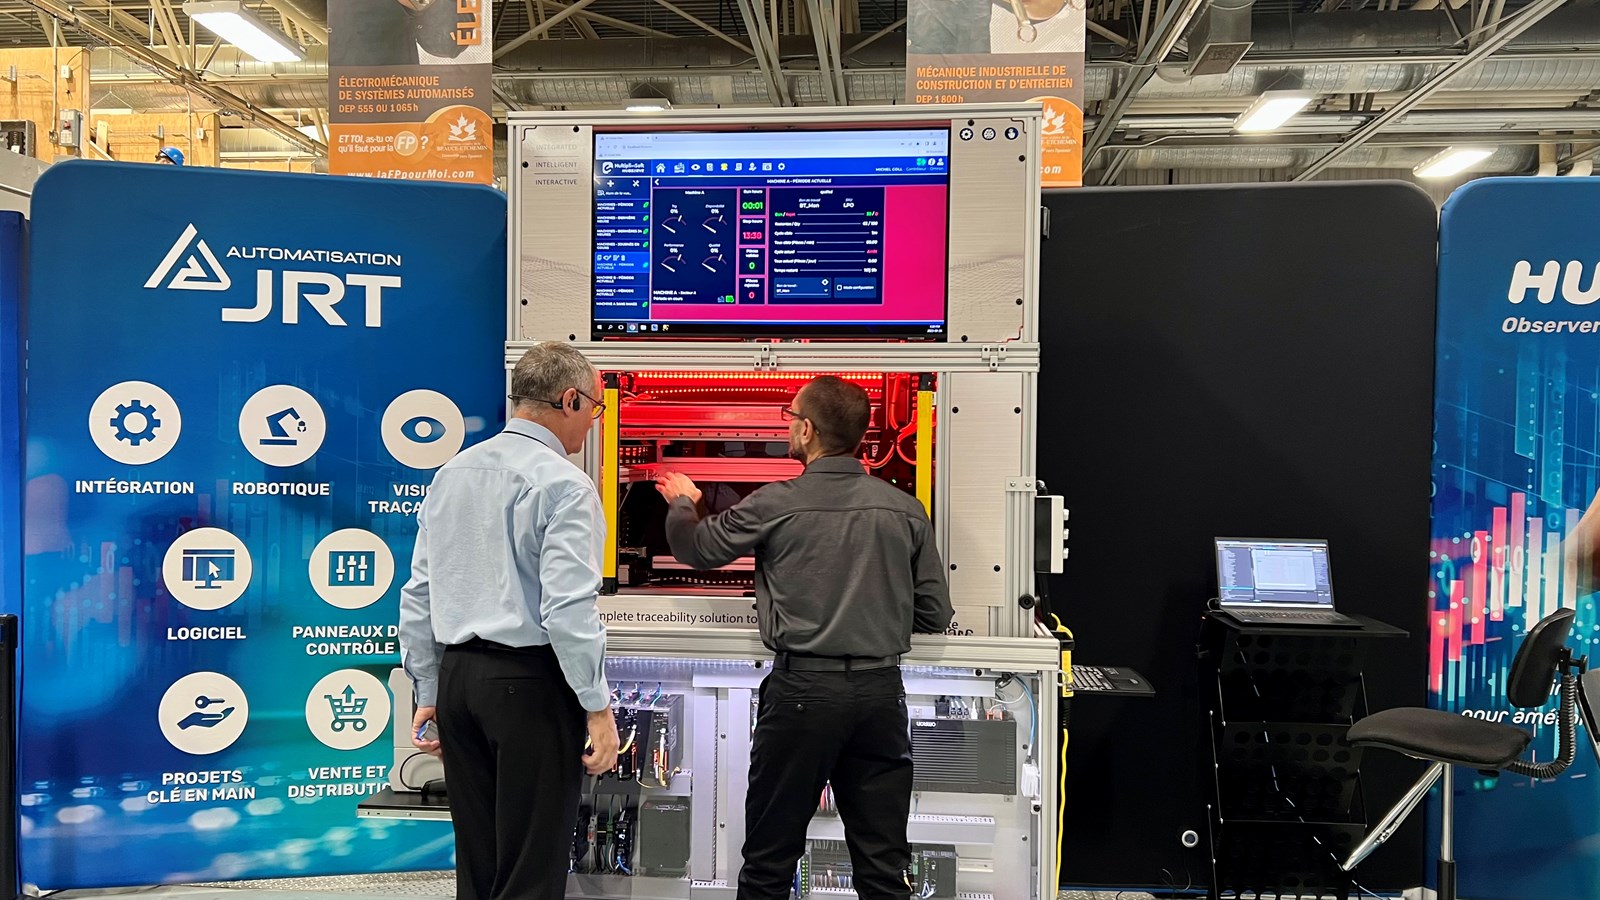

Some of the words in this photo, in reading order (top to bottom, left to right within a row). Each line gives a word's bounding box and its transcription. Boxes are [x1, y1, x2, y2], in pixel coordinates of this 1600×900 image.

[916, 66, 976, 78] MÉCANIQUE
[979, 66, 1049, 77] INDUSTRIELLE
[1052, 66, 1066, 76] DE
[338, 76, 440, 88] ÉLECTROMÉCANIQUE
[916, 79, 992, 90] CONSTRUCTION
[995, 79, 1006, 89] ET
[1010, 78, 1072, 88] D'ENTRETIEN
[338, 90, 352, 100] DE
[354, 88, 404, 100] SYSTÈMES
[406, 86, 474, 98] AUTOMATISÉS
[916, 95, 932, 103] DEP
[339, 104, 356, 112] DEP
[358, 104, 374, 112] 555
[376, 104, 388, 112] OU
[338, 134, 350, 142] ET
[350, 134, 364, 144] TOI,
[398, 136, 416, 150] FP
[420, 136, 428, 150] ?
[338, 145, 354, 153] qu'il
[742, 202, 763, 210] 00:01
[226, 246, 401, 266] AUTOMATISATION
[1508, 260, 1600, 304] HU
[222, 269, 401, 328] JRT
[75, 477, 194, 495] INTÉGRATION
[232, 482, 330, 497] ROBOTIQUE
[368, 500, 422, 516] TRAÇA
[600, 612, 634, 622] mplete
[636, 612, 696, 624] traceability
[700, 612, 744, 624] solution
[746, 614, 758, 624] to
[167, 627, 246, 640] LOGICIEL
[292, 625, 384, 638] PANNEAUX
[388, 625, 398, 638] D
[306, 638, 394, 656] CONTRÔLE
[162, 770, 242, 785] PROJETS
[308, 766, 362, 780] VENTE
[366, 766, 386, 778] ET
[147, 786, 182, 804] CLÉ
[184, 788, 209, 802] EN
[212, 787, 256, 802] MAIN
